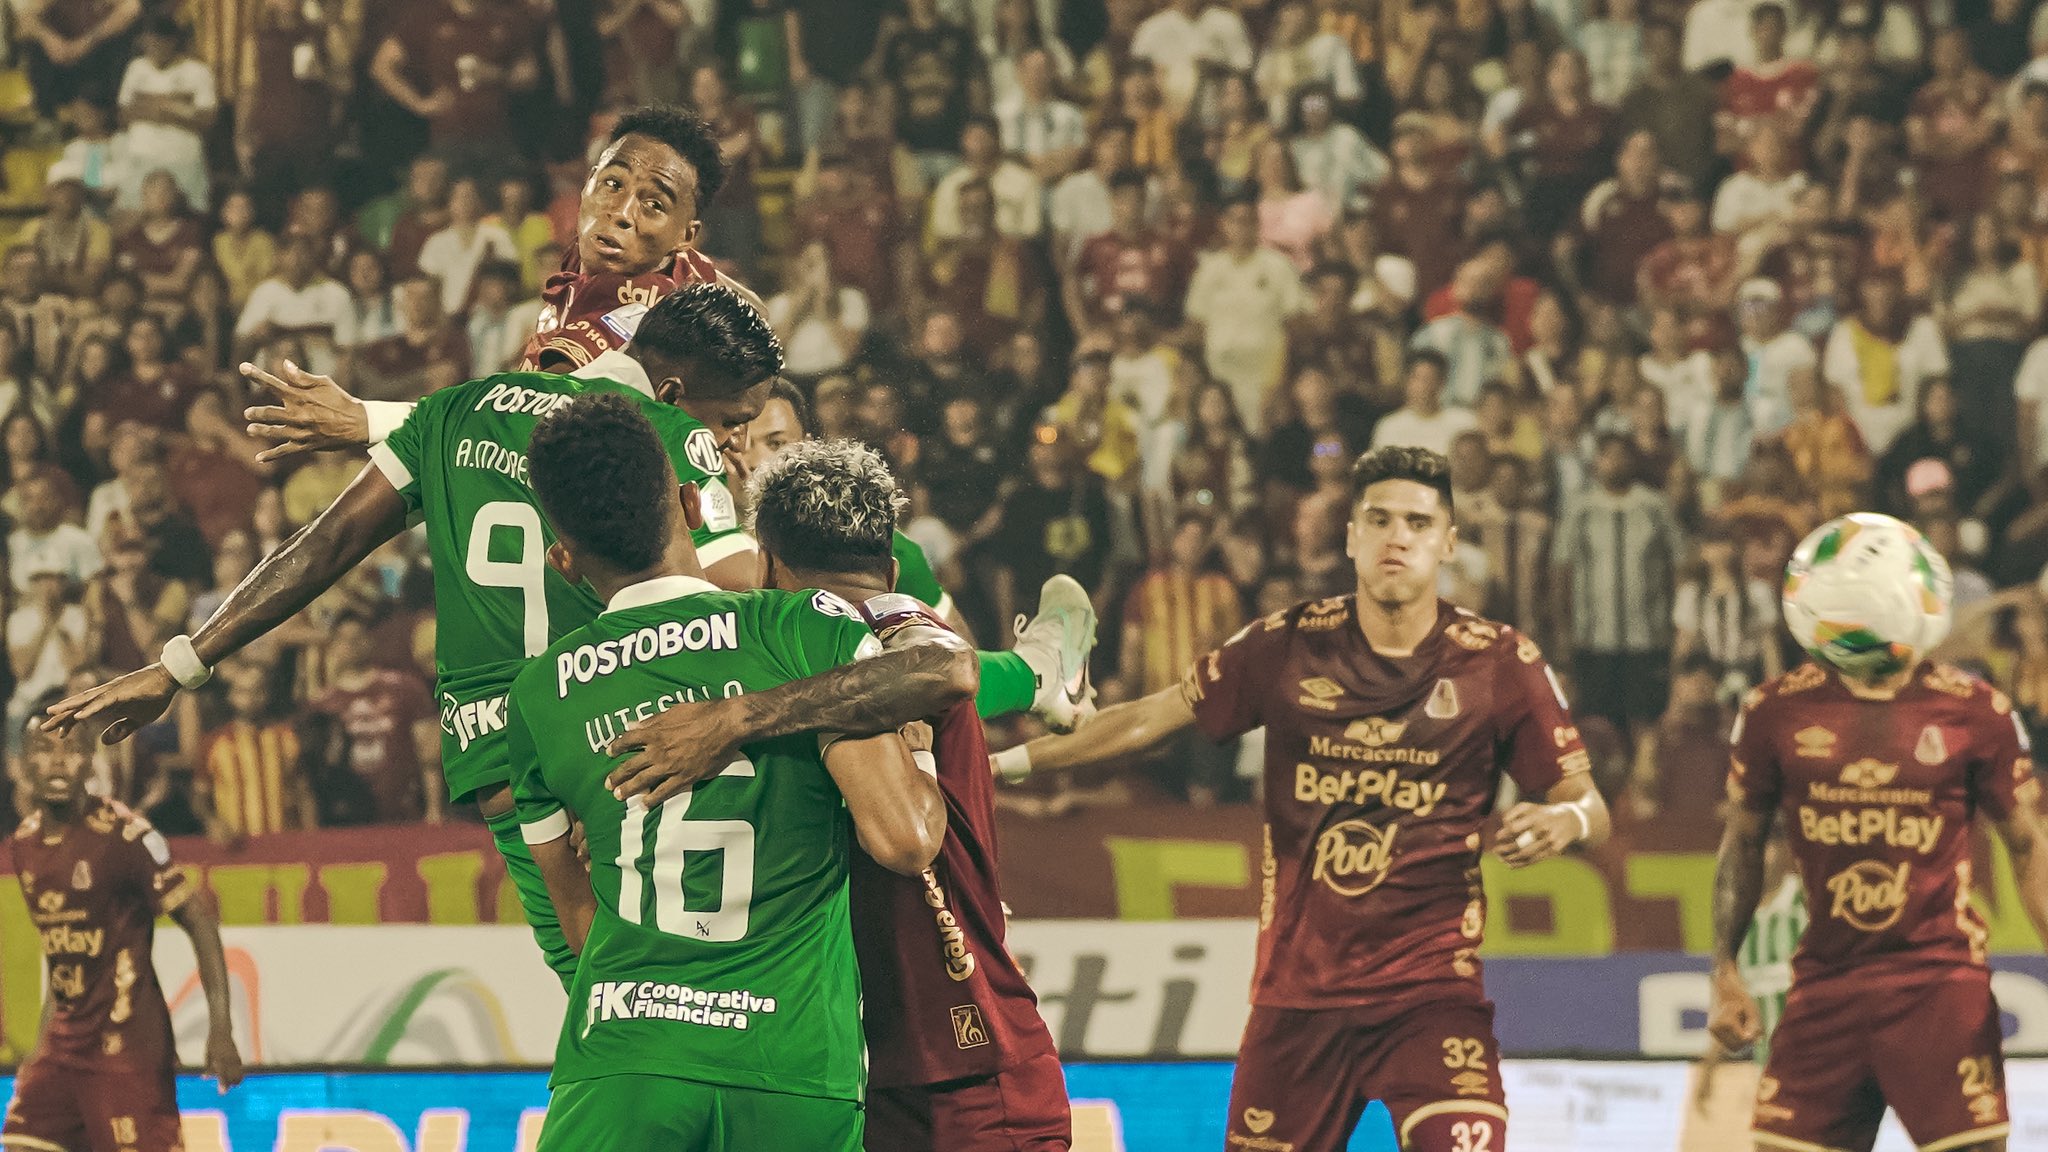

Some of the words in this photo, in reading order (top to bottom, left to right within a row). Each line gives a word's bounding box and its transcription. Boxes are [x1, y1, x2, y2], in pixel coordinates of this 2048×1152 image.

[617, 279, 664, 309] dal
[455, 438, 535, 489] A.MORE
[466, 501, 549, 657] 9
[556, 611, 739, 699] POSTOBON
[453, 696, 505, 752] JFK
[1295, 763, 1447, 817] BetPlay
[619, 752, 756, 942] 16
[1312, 822, 1399, 881] Pool
[1799, 805, 1945, 855] BetPlay
[1826, 860, 1911, 918] Pool
[632, 999, 749, 1031] Financiera
[637, 981, 777, 1014] Cooperativa
[1442, 1036, 1488, 1070] 32
[1451, 1119, 1493, 1152] 32
